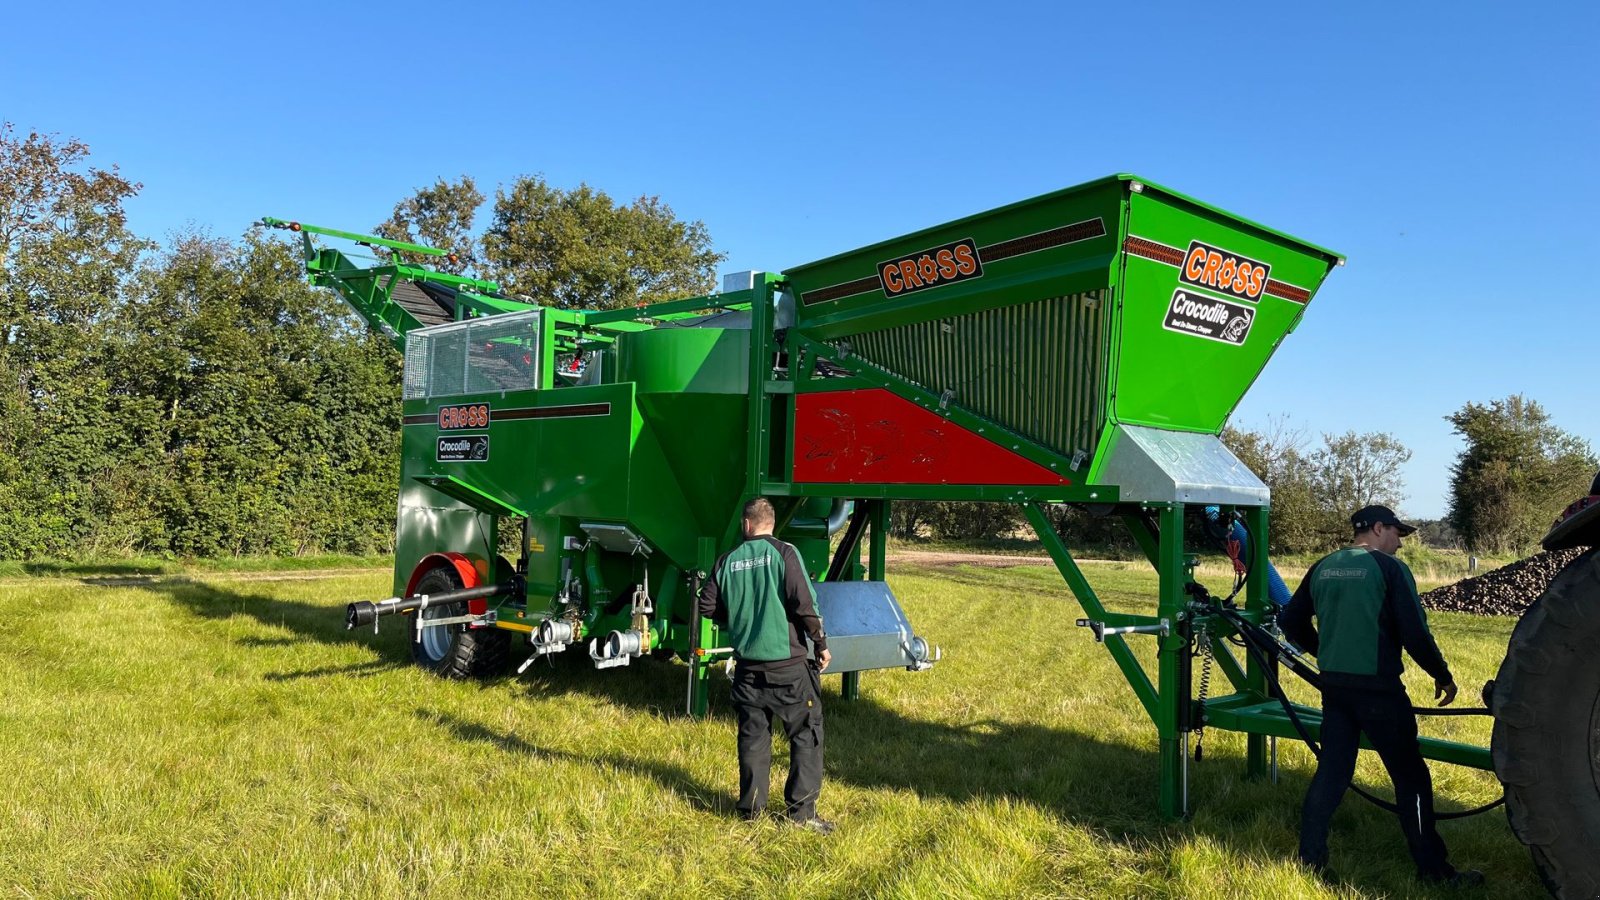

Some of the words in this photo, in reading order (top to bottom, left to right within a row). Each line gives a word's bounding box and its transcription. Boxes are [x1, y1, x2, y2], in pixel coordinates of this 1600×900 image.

[883, 244, 976, 293] CROSS
[1186, 247, 1265, 298] CROSS
[1172, 293, 1229, 325] Crocodile
[440, 405, 488, 429] CROSS
[440, 440, 471, 451] Crocodile
